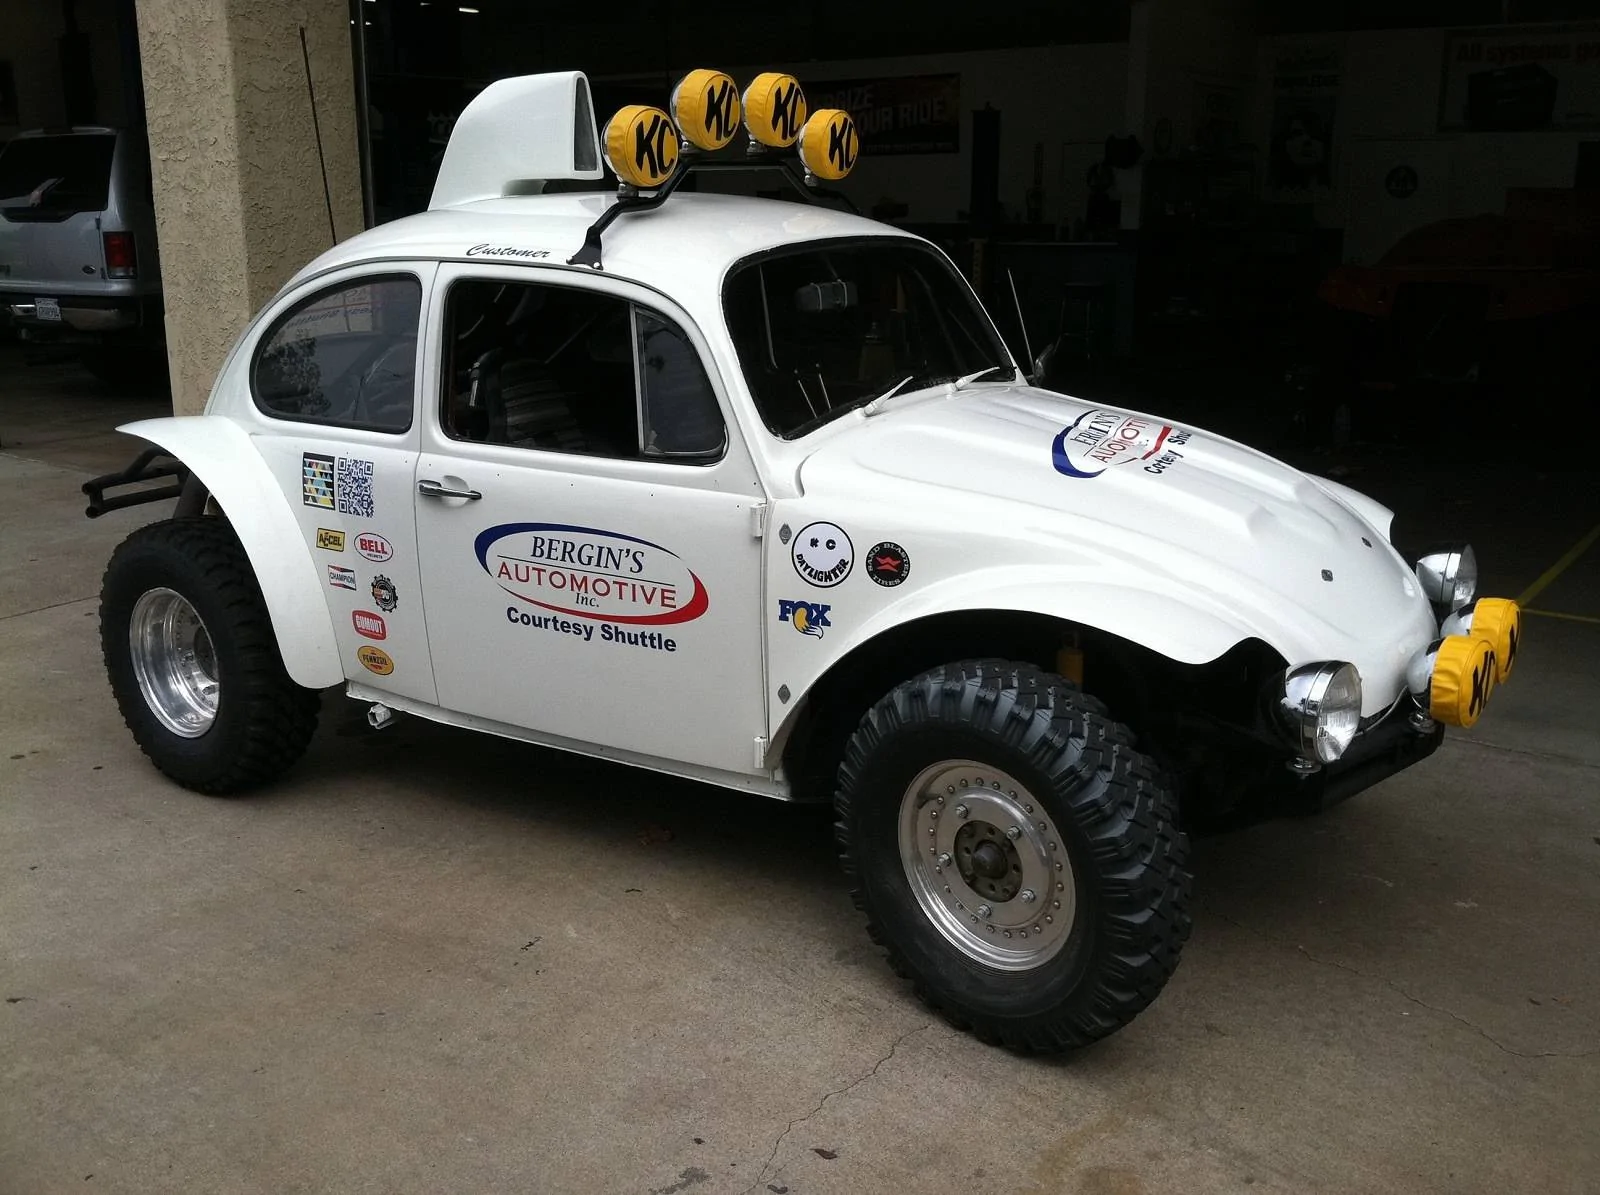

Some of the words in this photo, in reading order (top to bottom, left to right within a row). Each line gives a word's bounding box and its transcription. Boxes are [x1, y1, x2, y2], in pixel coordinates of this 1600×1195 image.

[704, 80, 738, 141] KC
[771, 82, 804, 141] KC
[855, 107, 893, 134] OUR
[635, 115, 675, 178] KC
[829, 117, 858, 171] KC
[466, 243, 551, 258] Customer
[359, 538, 388, 555] BELL
[530, 535, 645, 574] BERGIN'S
[825, 539, 837, 550] C
[867, 546, 881, 571] SAND
[329, 571, 356, 585] CHAMPION
[796, 553, 850, 583] DAYLIGHTER
[497, 560, 677, 609] AUTOMOTIVE
[575, 592, 601, 608] Inc.
[778, 599, 832, 628] FOX
[355, 614, 384, 635] GUMOUT
[506, 606, 594, 642] Courtesy
[600, 623, 677, 652] Shuttle
[362, 654, 388, 666] PENNZOIL
